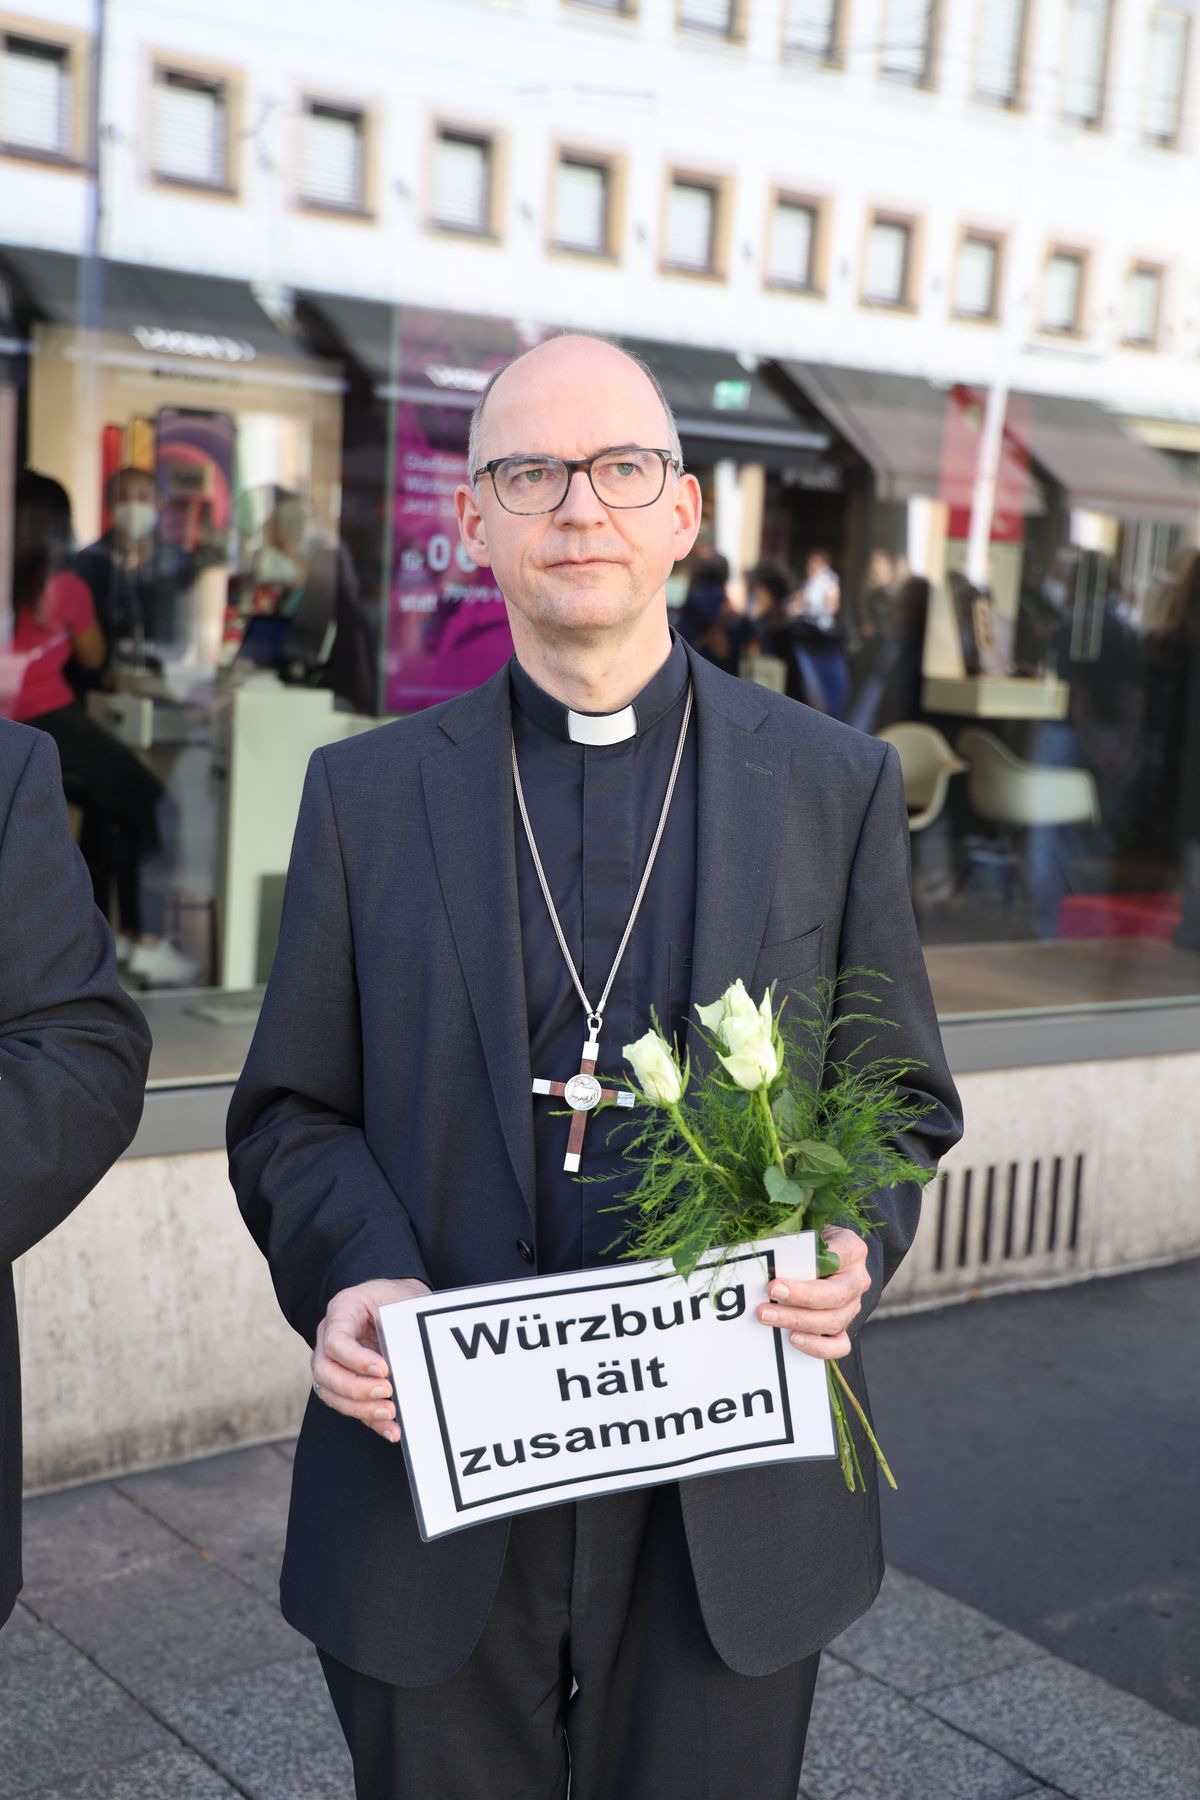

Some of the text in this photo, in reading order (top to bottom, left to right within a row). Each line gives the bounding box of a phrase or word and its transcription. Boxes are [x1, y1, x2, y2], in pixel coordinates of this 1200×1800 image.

[428, 534, 450, 571] 0
[450, 1284, 746, 1360] Würzburg
[557, 1355, 669, 1402] hält
[460, 1388, 775, 1477] zusammen
